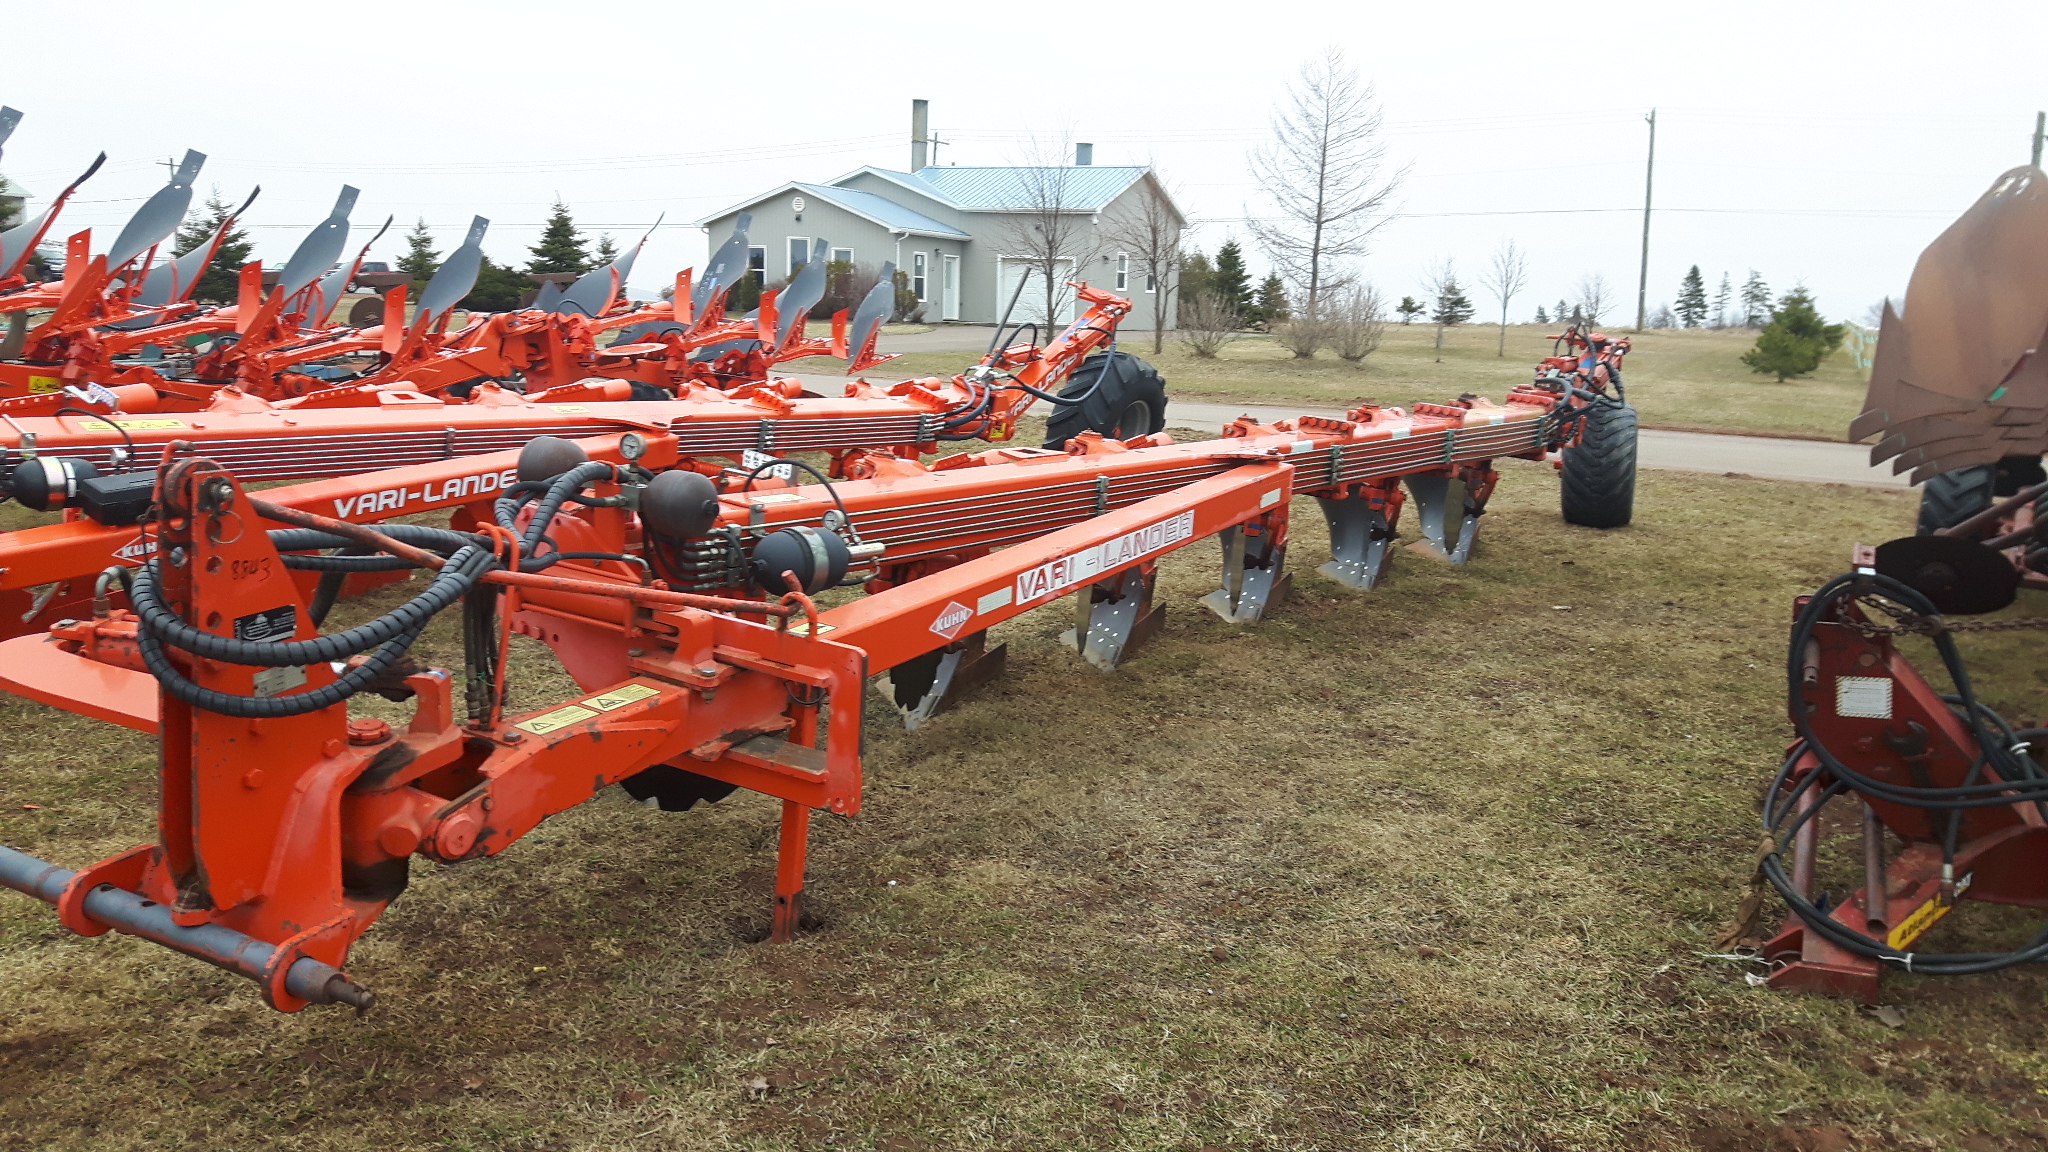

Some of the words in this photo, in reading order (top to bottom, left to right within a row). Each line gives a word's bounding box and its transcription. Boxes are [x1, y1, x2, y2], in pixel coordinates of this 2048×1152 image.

[334, 468, 519, 518] VARI-LANDE
[121, 541, 158, 558] KUH
[936, 609, 969, 632] KUHN
